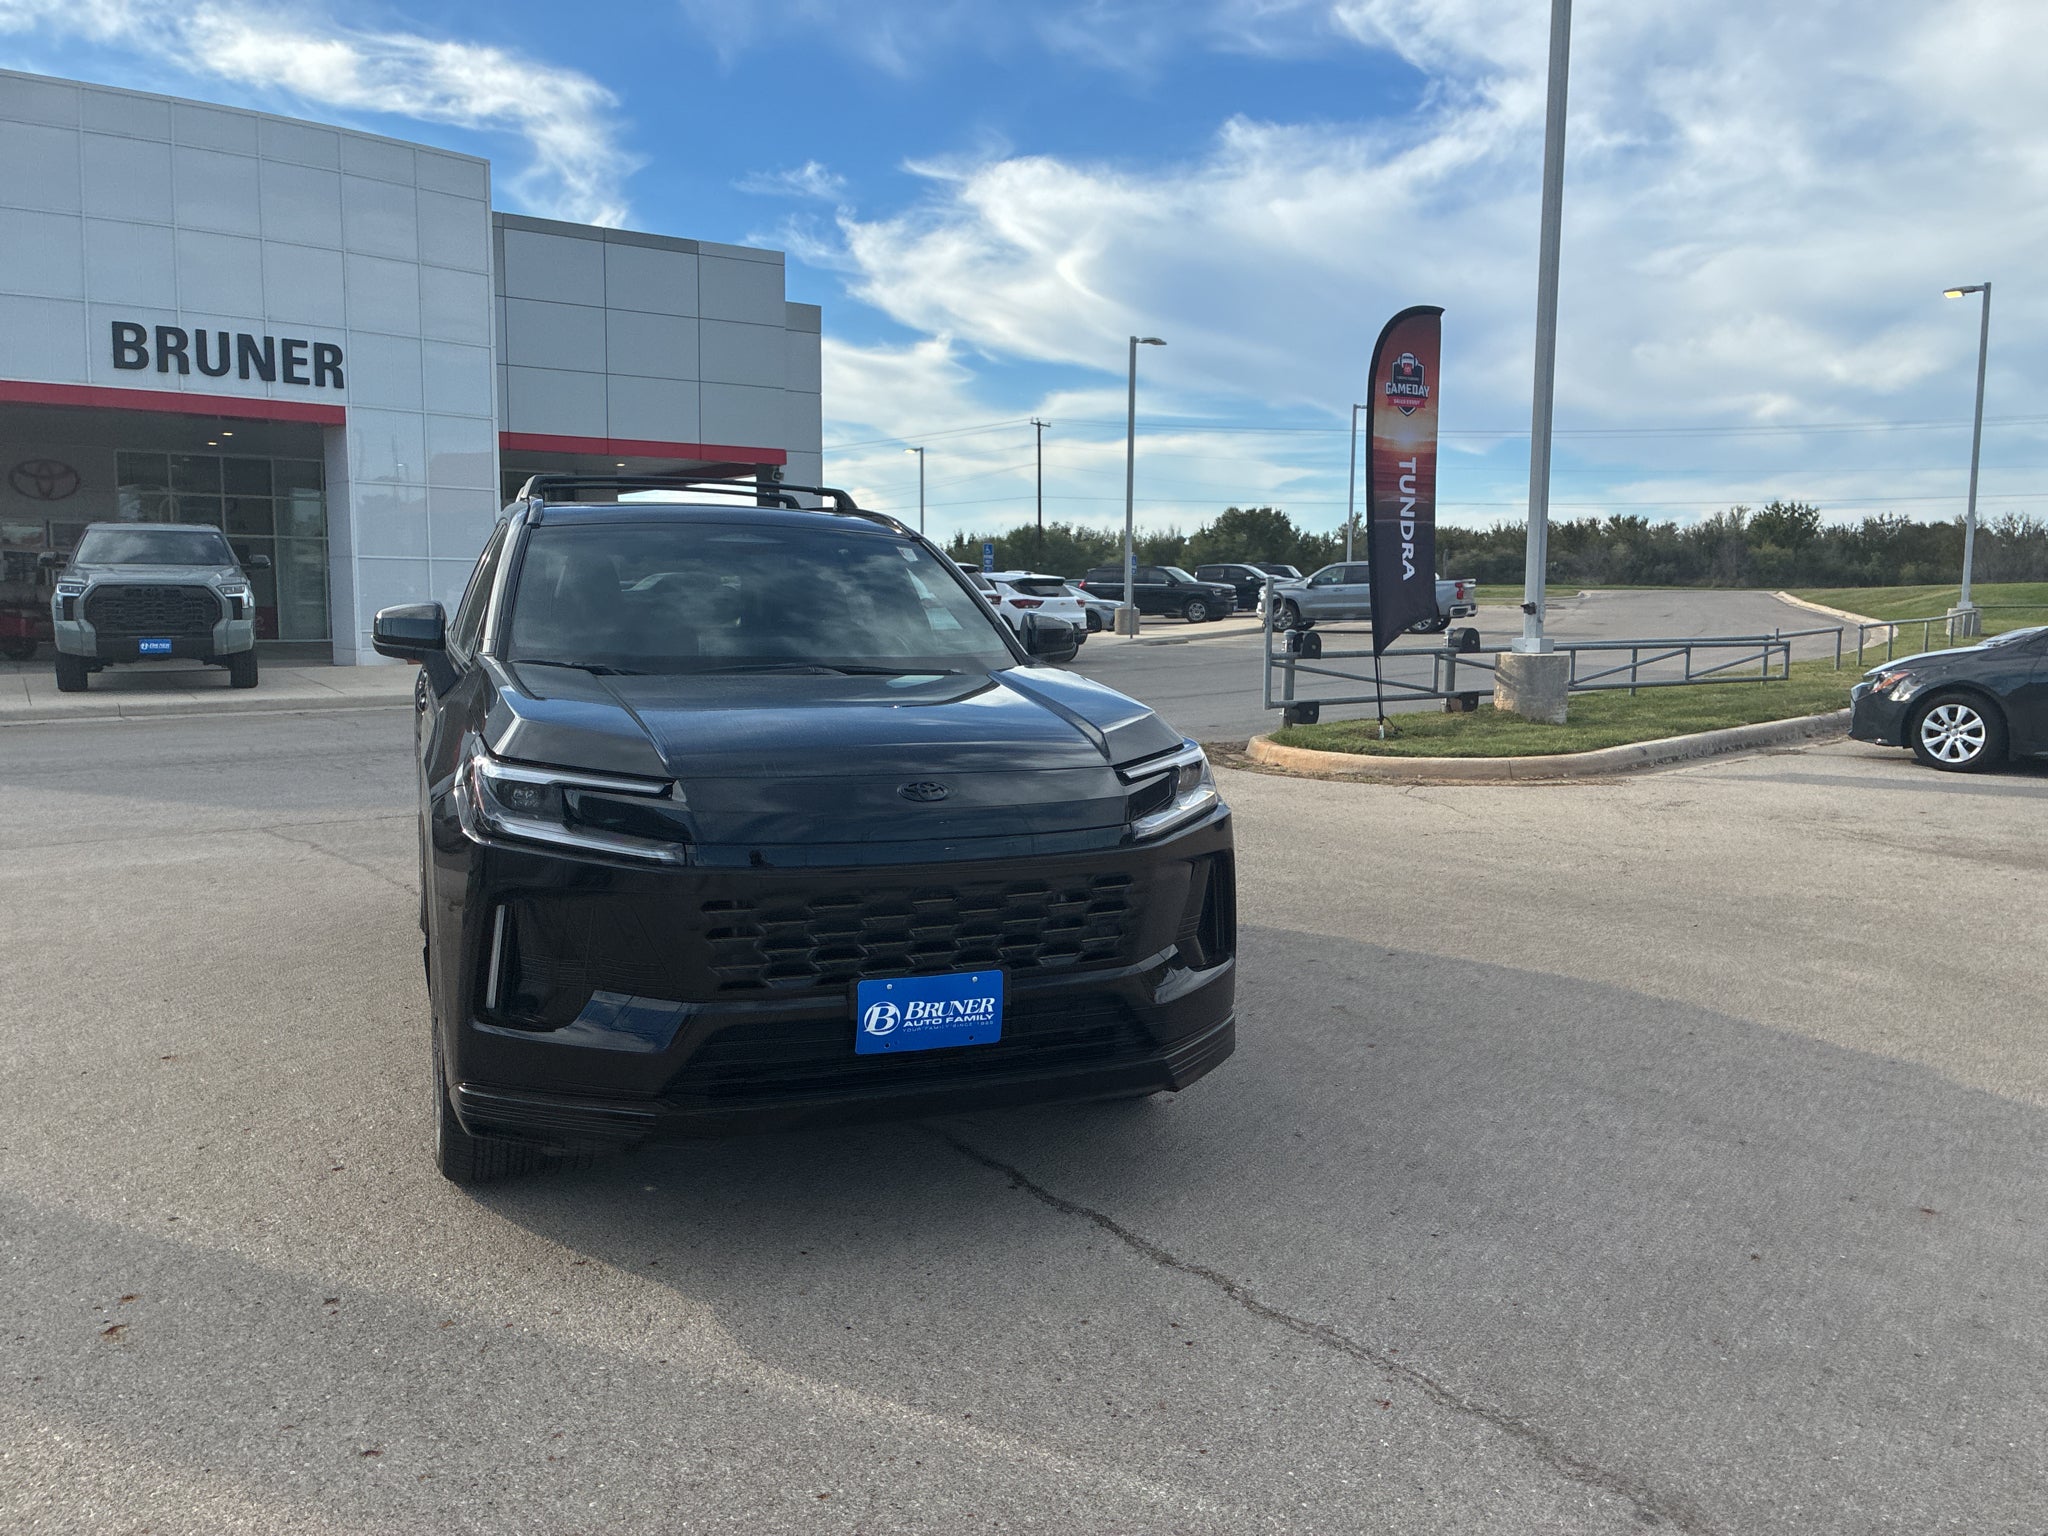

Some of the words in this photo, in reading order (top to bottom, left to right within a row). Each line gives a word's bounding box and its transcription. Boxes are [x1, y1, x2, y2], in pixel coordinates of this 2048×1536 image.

[112, 321, 344, 389] BRUNER
[1386, 382, 1430, 397] GAMEDAY
[1398, 457, 1417, 581] TUNDRA
[864, 1005, 897, 1032] B
[903, 1018, 942, 1027] AUTO
[946, 1013, 995, 1024] FAMILY
[904, 997, 995, 1020] BRUNER
